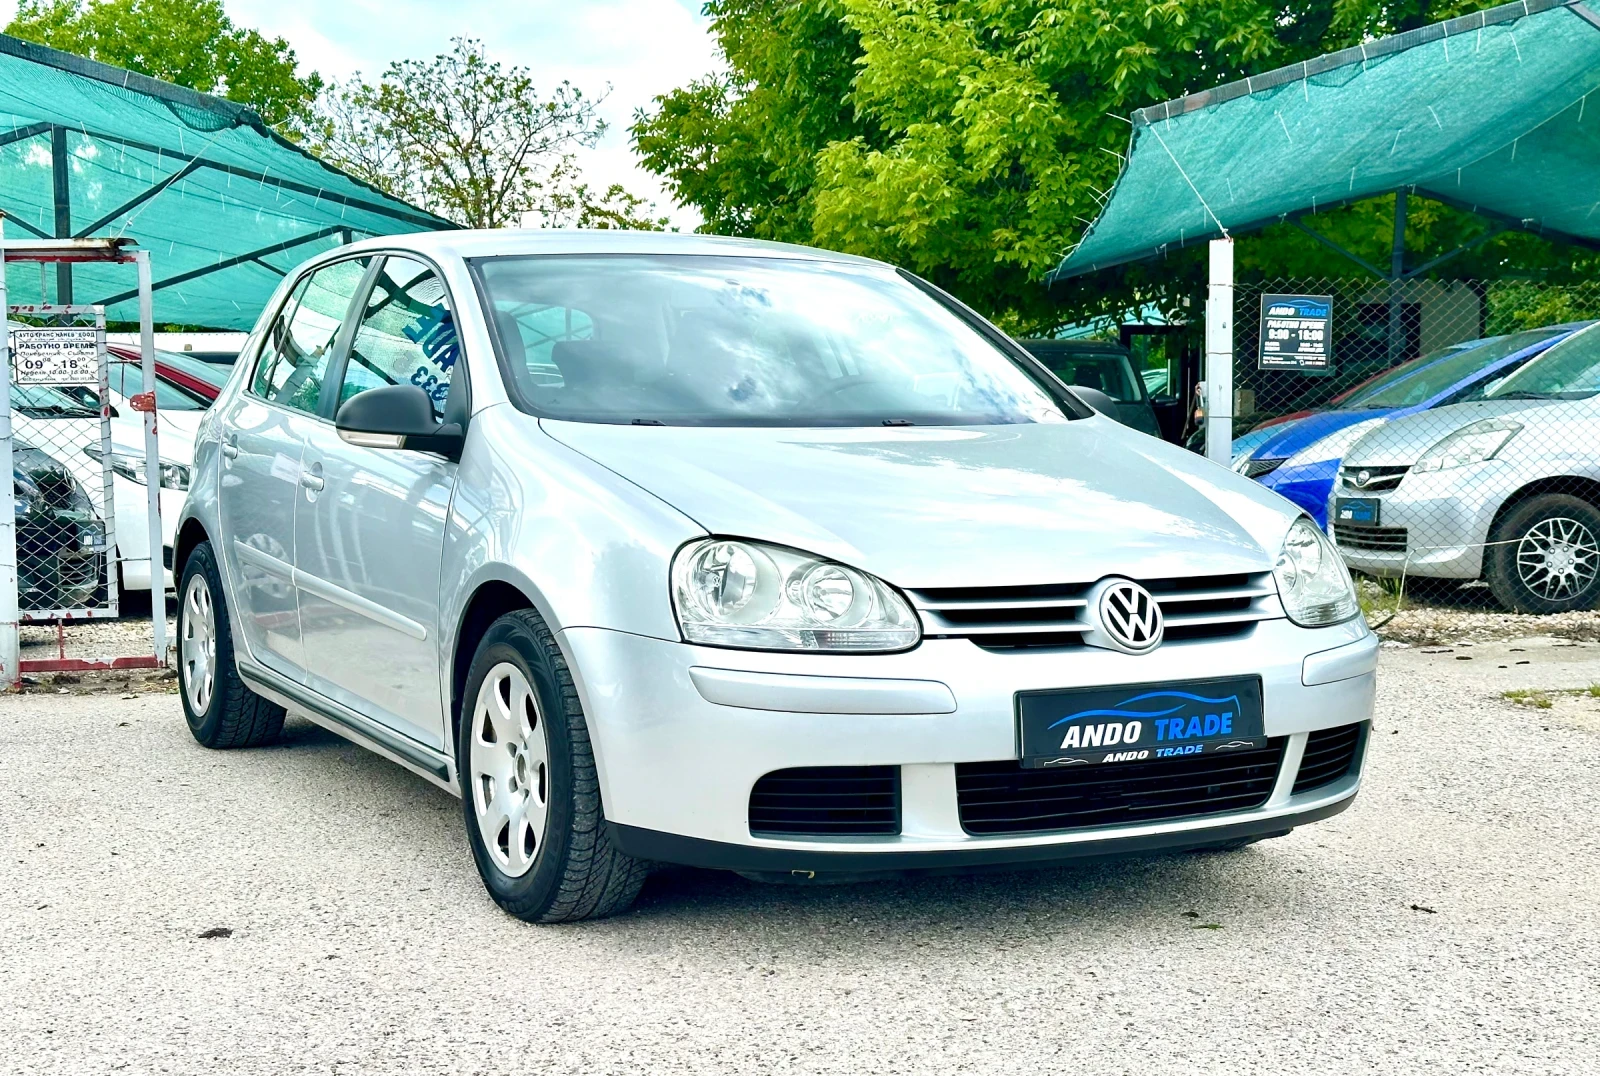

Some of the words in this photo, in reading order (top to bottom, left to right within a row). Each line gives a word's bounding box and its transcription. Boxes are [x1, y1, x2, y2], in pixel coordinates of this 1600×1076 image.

[1268, 307, 1295, 315] ANDO
[1299, 308, 1327, 316] TRADE
[1268, 329, 1289, 340] 9:00
[1060, 720, 1142, 749] ANDO
[1154, 712, 1233, 741] TRADE
[1102, 750, 1149, 763] ANDO
[1156, 744, 1204, 757] TRADE
